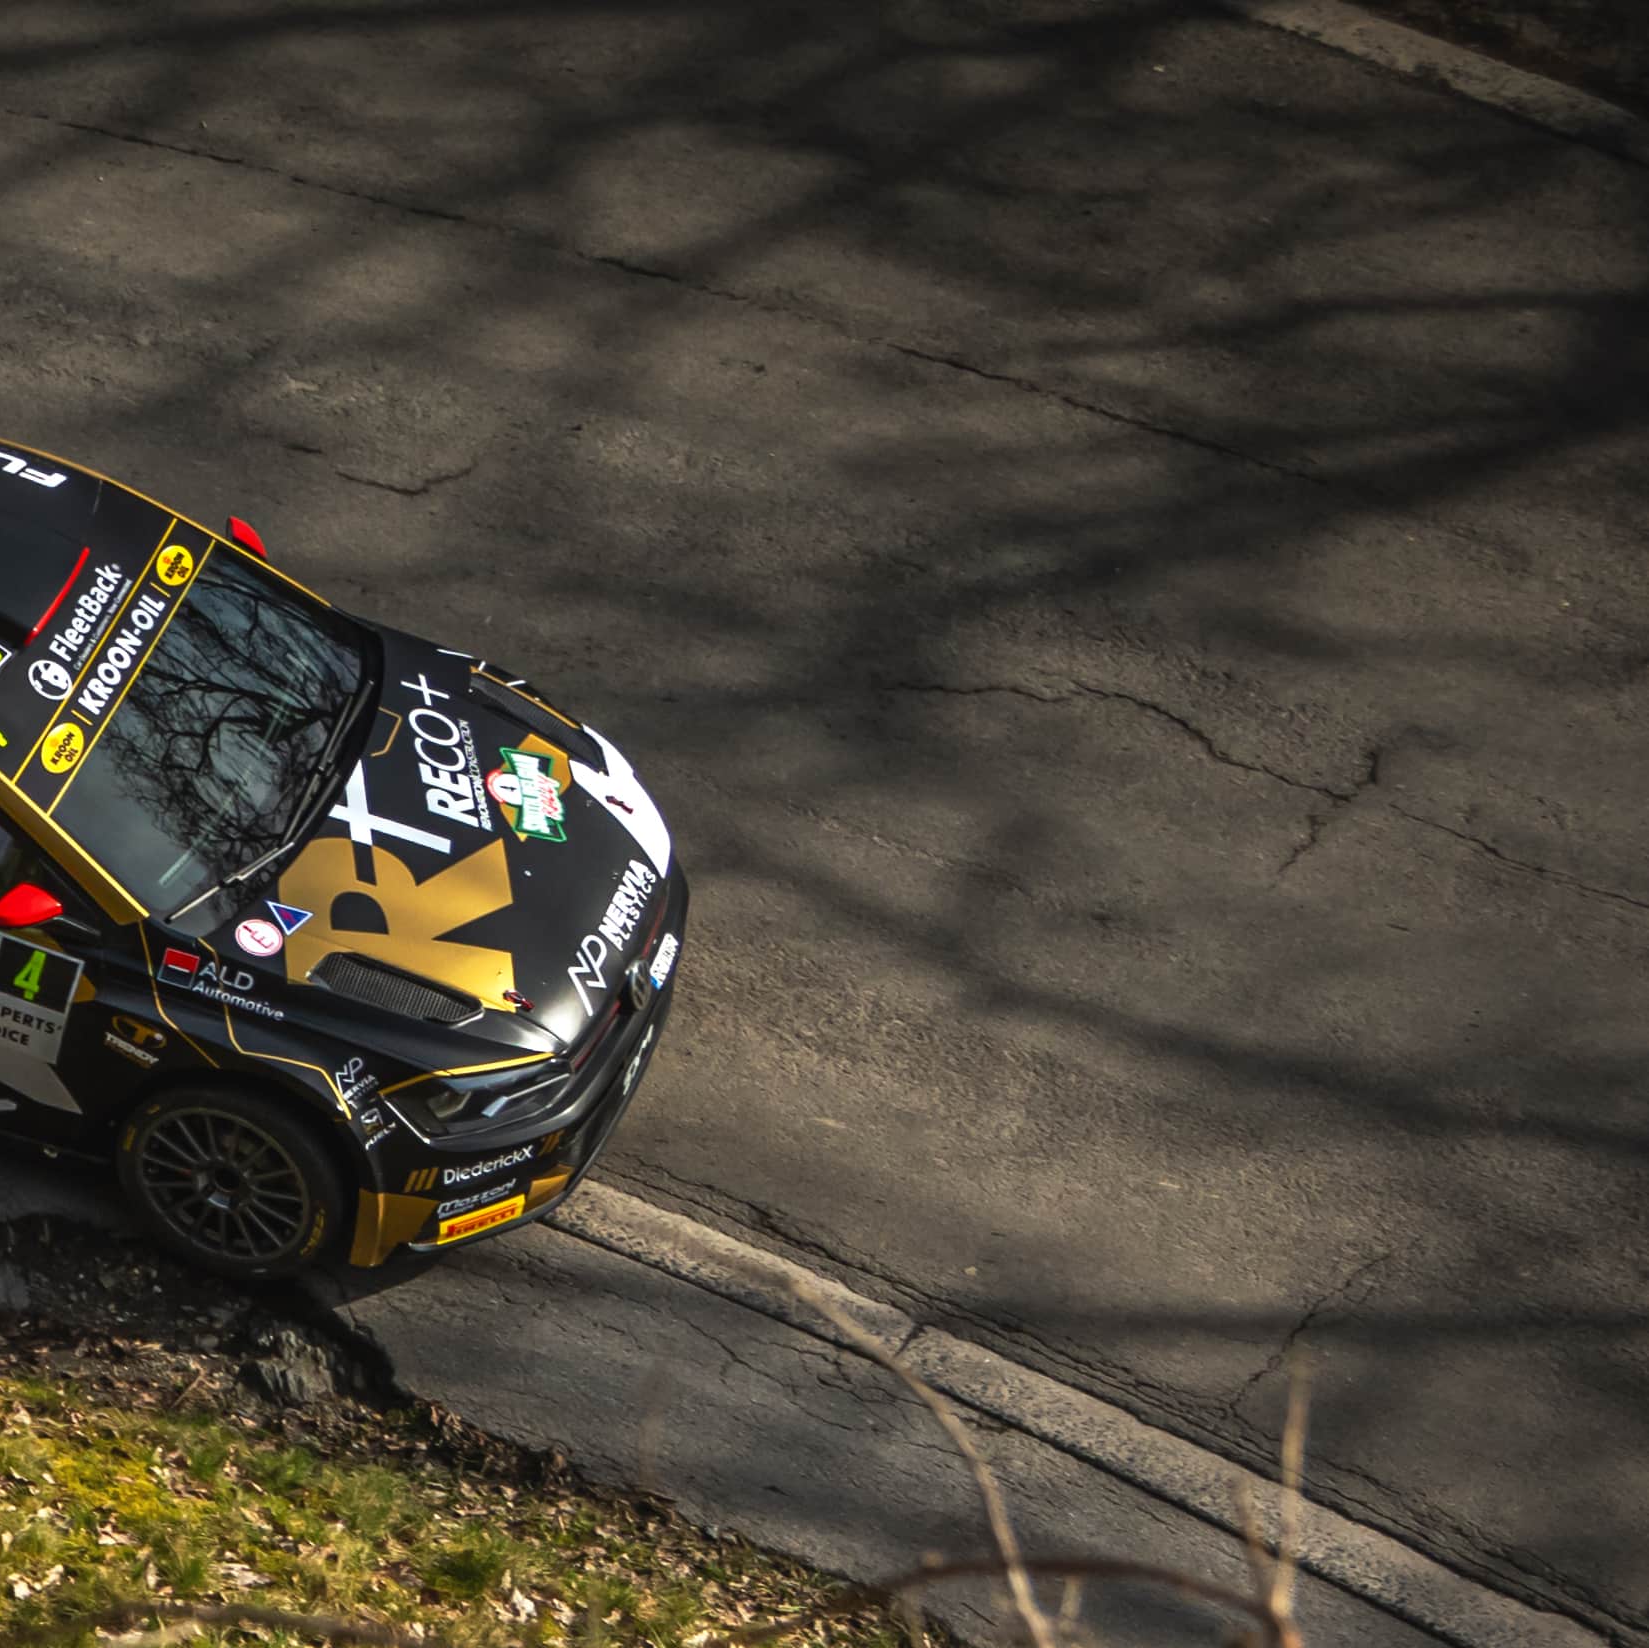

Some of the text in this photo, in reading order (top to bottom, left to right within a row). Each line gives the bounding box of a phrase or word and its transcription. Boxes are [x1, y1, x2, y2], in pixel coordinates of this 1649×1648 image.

[77, 594, 166, 716] KROON-OIL
[49, 731, 76, 766] KROON
[64, 747, 78, 763] OIL
[599, 859, 648, 945] NERVIA
[611, 870, 657, 951] PLASTICS
[13, 950, 47, 1001] 4
[197, 961, 255, 992] ALD
[192, 981, 286, 1022] Automotive
[445, 1201, 518, 1239] PIRELLI
